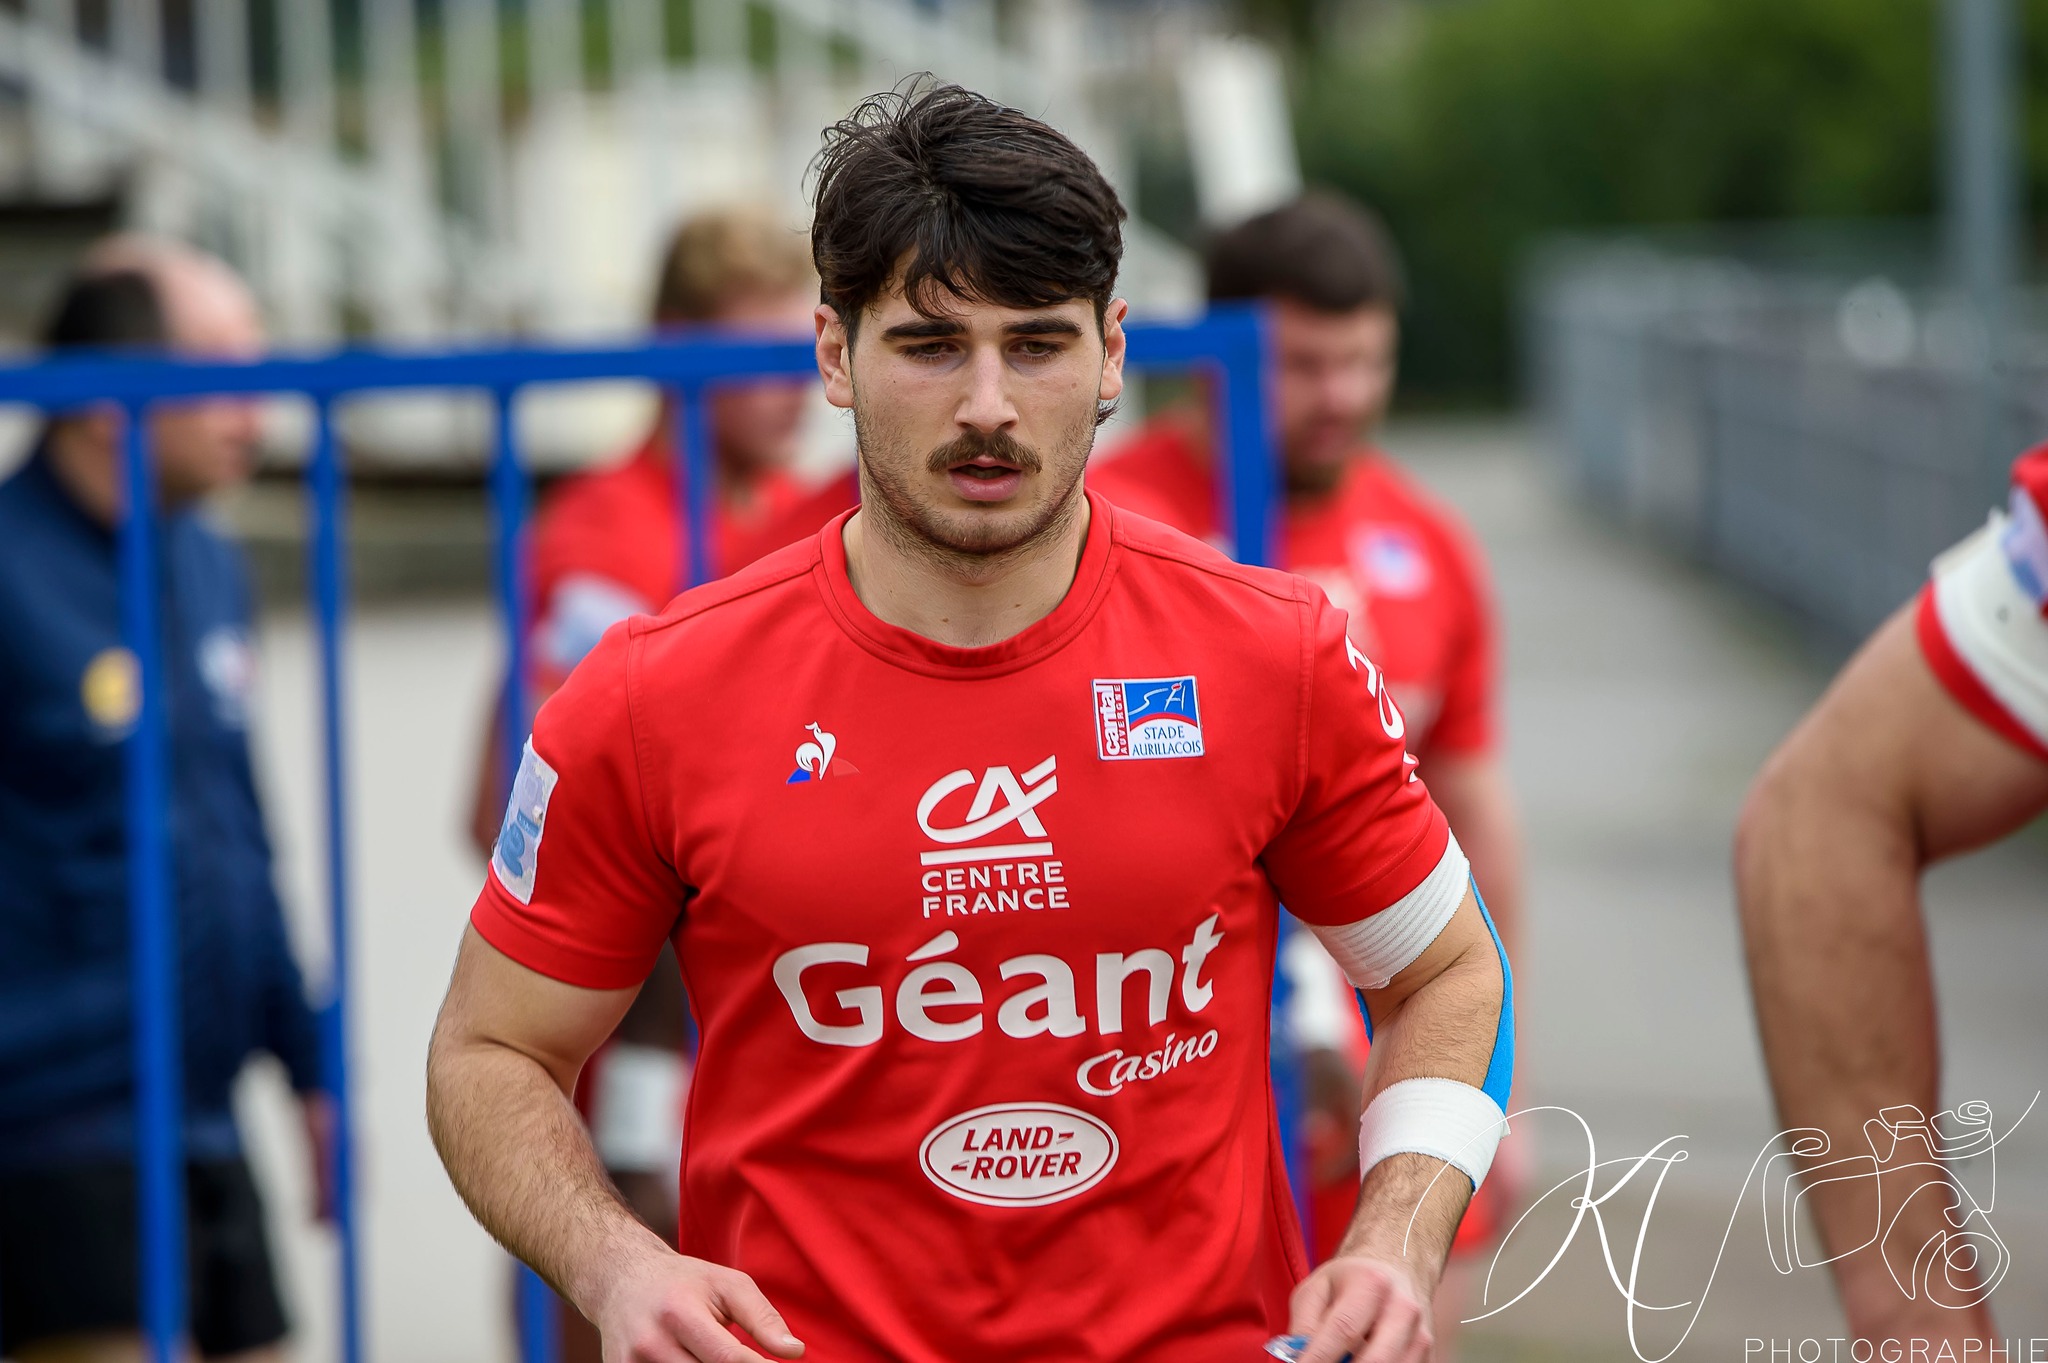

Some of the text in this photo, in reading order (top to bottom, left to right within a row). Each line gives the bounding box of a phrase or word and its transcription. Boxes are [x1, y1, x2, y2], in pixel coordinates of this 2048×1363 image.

[1096, 684, 1121, 756] cantal
[1114, 684, 1129, 754] AUVERGNE
[1144, 725, 1186, 740] STADE
[1132, 740, 1202, 757] AURILLACOIS
[921, 860, 1066, 893] CENTRE
[922, 886, 1071, 919] FRANCE
[772, 912, 1226, 1048] Géant
[1075, 1028, 1219, 1097] Casino
